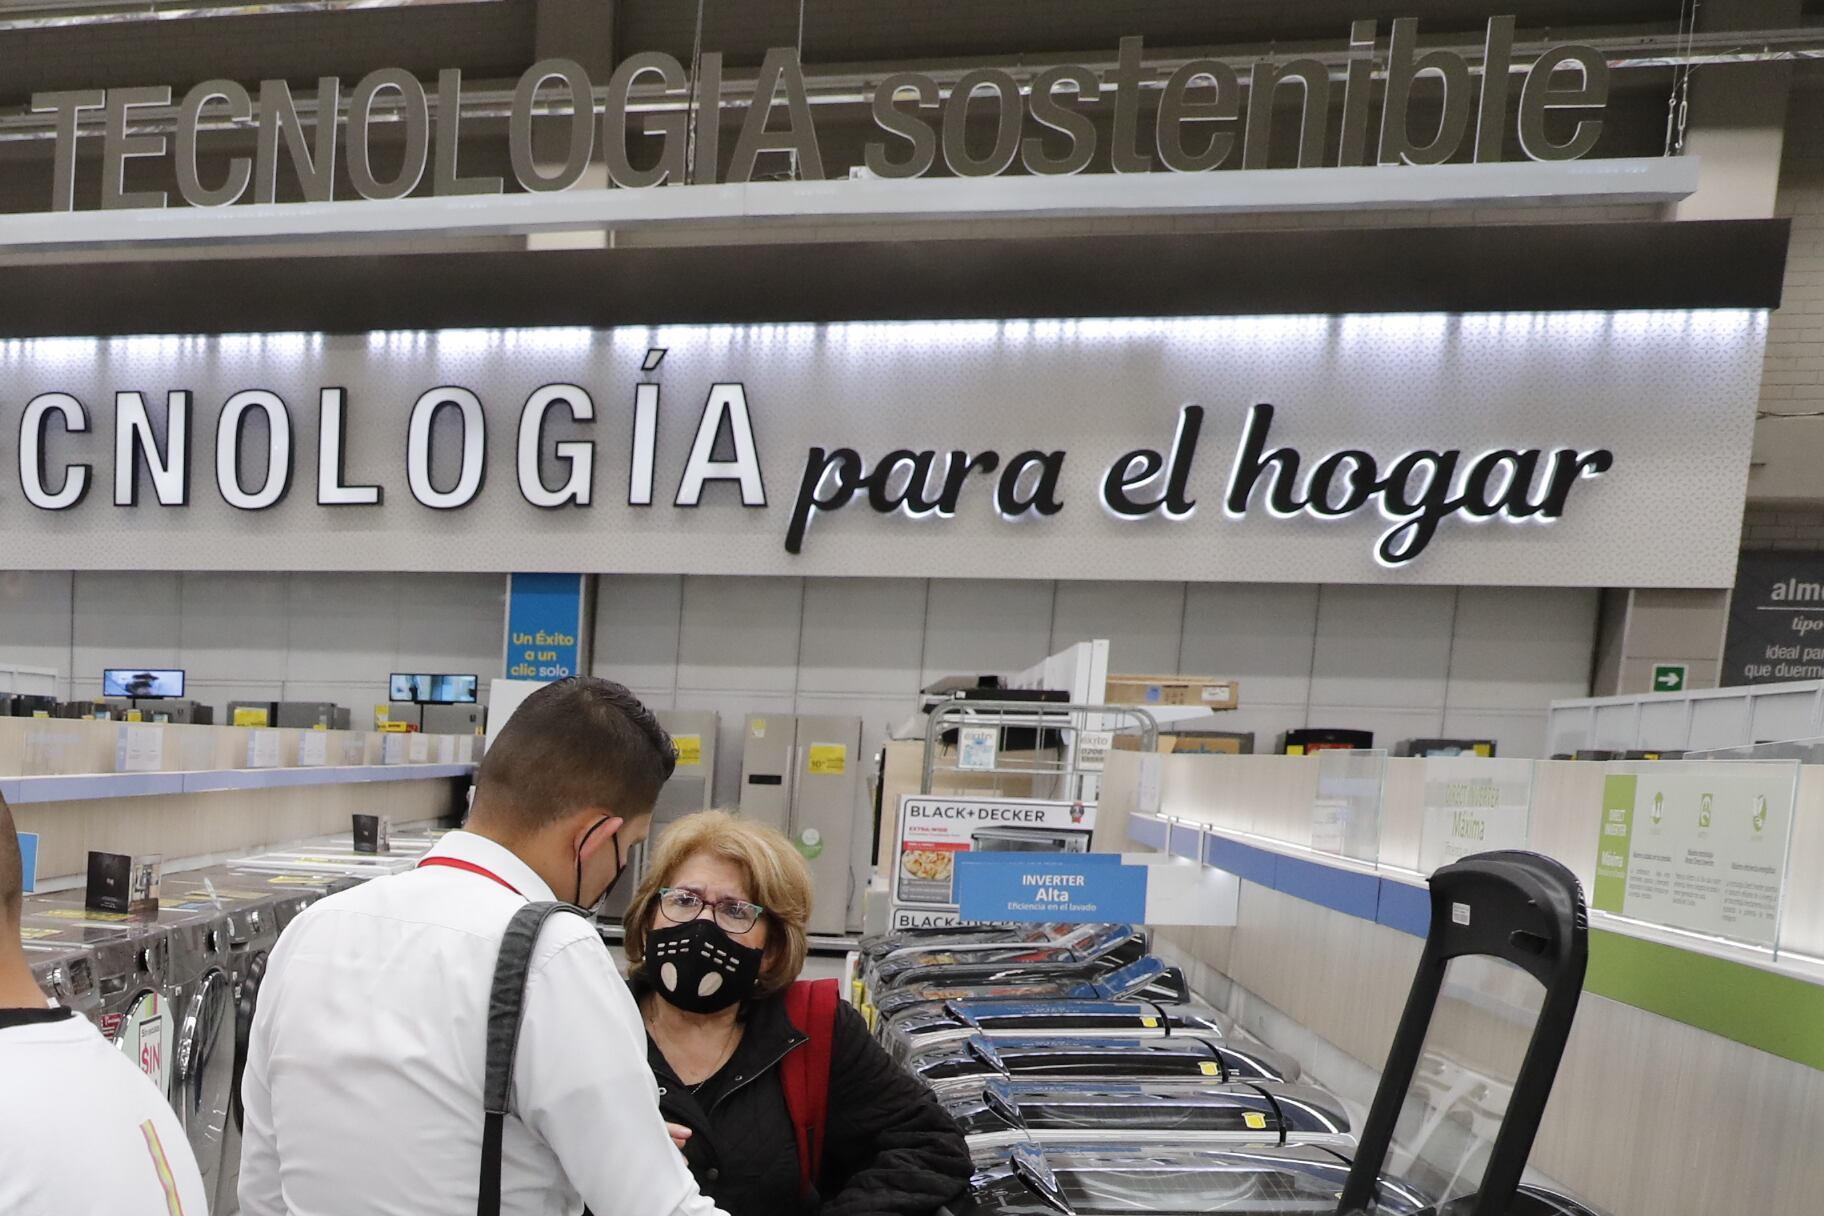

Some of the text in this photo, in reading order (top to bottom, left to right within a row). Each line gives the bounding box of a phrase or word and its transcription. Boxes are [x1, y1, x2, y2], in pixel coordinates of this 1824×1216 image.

[31, 15, 1610, 213] TECNOLOGIA sostenible
[784, 445, 1067, 555] para
[1101, 404, 1205, 520] el
[1225, 403, 1614, 568] hogar
[1770, 578, 1824, 601] alm
[513, 629, 575, 646] Un Éxito
[524, 650, 557, 661] a un
[1766, 645, 1800, 660] ideal
[511, 663, 569, 677] clic solo
[1745, 662, 1824, 679] que duerm
[909, 804, 1046, 822] BLACK+DECKER
[1022, 875, 1085, 886] INVERTER
[1035, 887, 1070, 902] Alta
[1007, 902, 1097, 911] Eficiencia en el lavado
